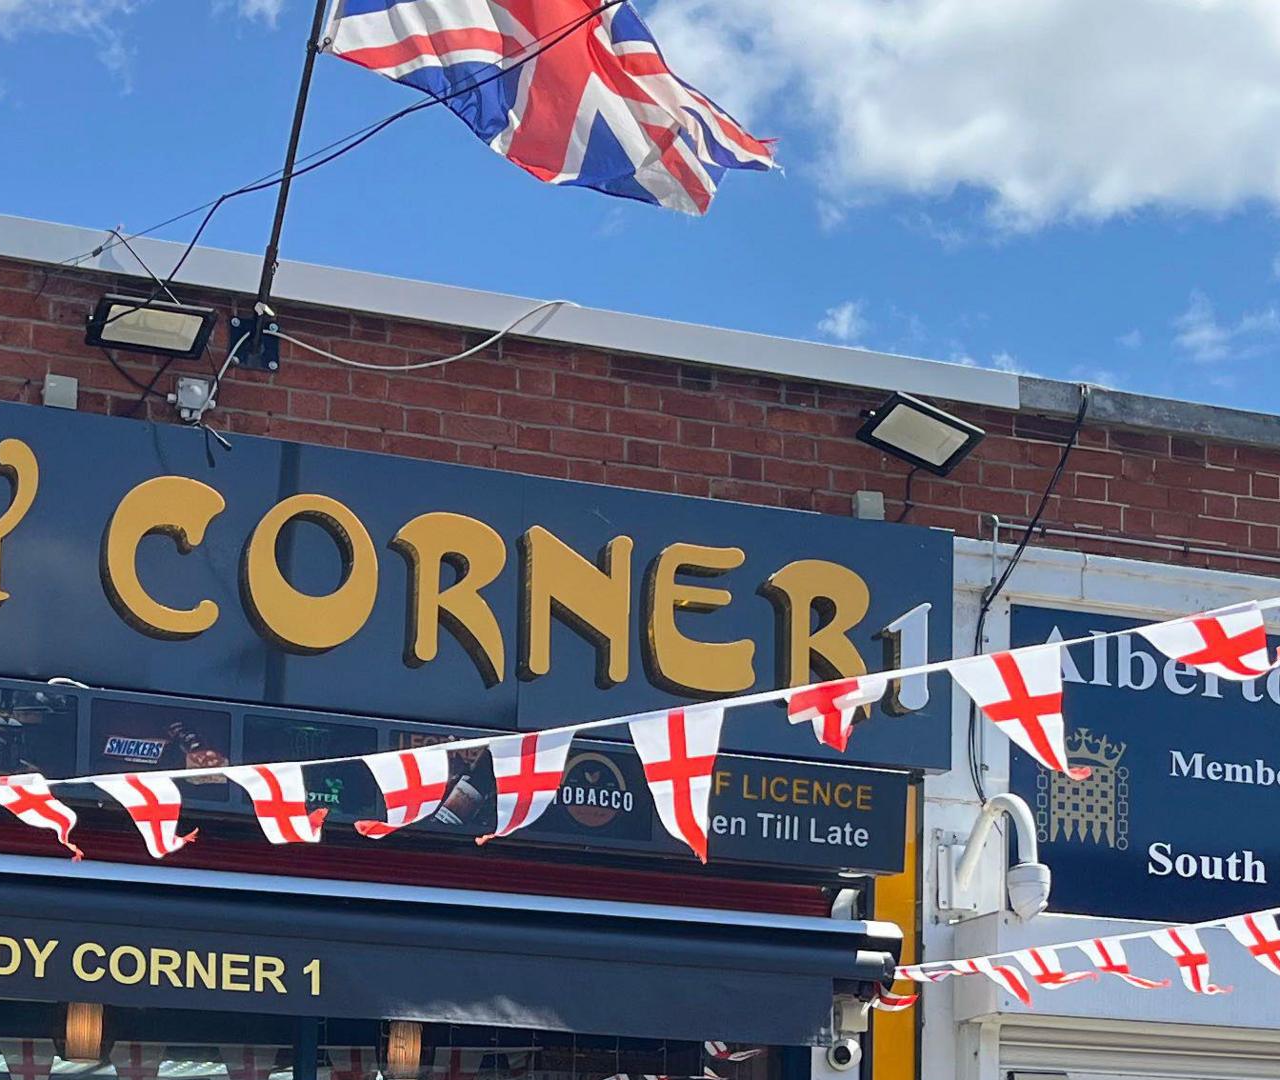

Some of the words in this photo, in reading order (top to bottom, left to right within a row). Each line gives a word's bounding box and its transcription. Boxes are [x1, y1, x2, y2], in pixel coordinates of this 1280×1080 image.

[100, 475, 872, 719] CORNER
[875, 602, 932, 716] 1
[107, 737, 164, 759] SNICKERS
[742, 773, 873, 811] LICENCE
[756, 811, 800, 842] Till
[808, 817, 870, 849] Late
[1147, 842, 1267, 887] South
[72, 942, 288, 995] CORNER
[301, 958, 321, 996] 1
